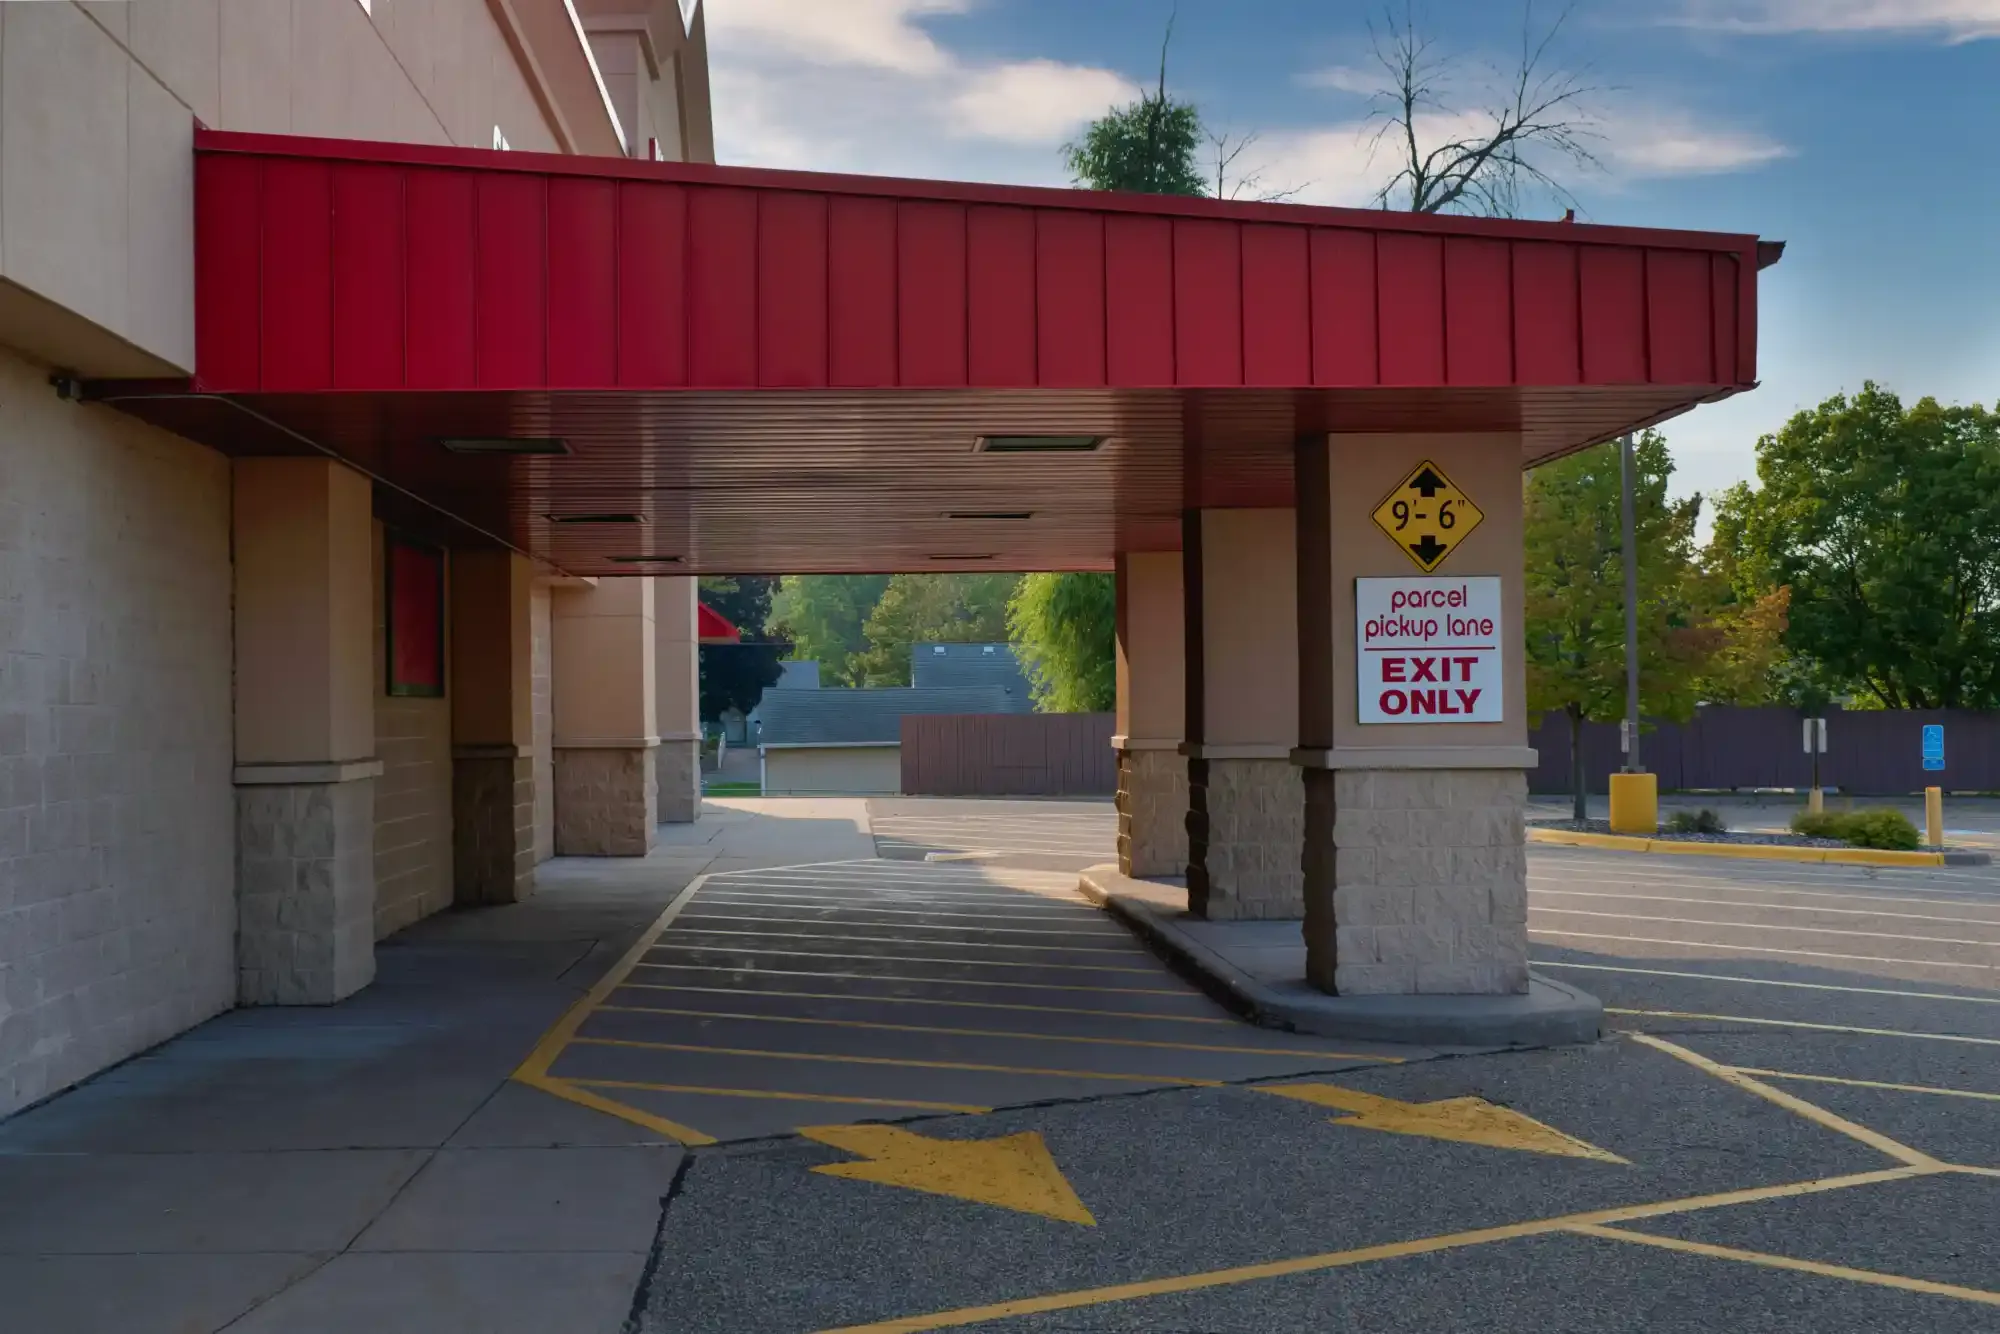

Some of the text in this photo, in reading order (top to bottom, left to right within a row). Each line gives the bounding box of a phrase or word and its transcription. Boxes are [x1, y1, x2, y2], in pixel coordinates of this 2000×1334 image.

[1391, 585, 1467, 613] parcel
[1365, 613, 1494, 642] pickup lane
[1381, 656, 1479, 682] EXIT
[1379, 688, 1482, 715] ONLY
